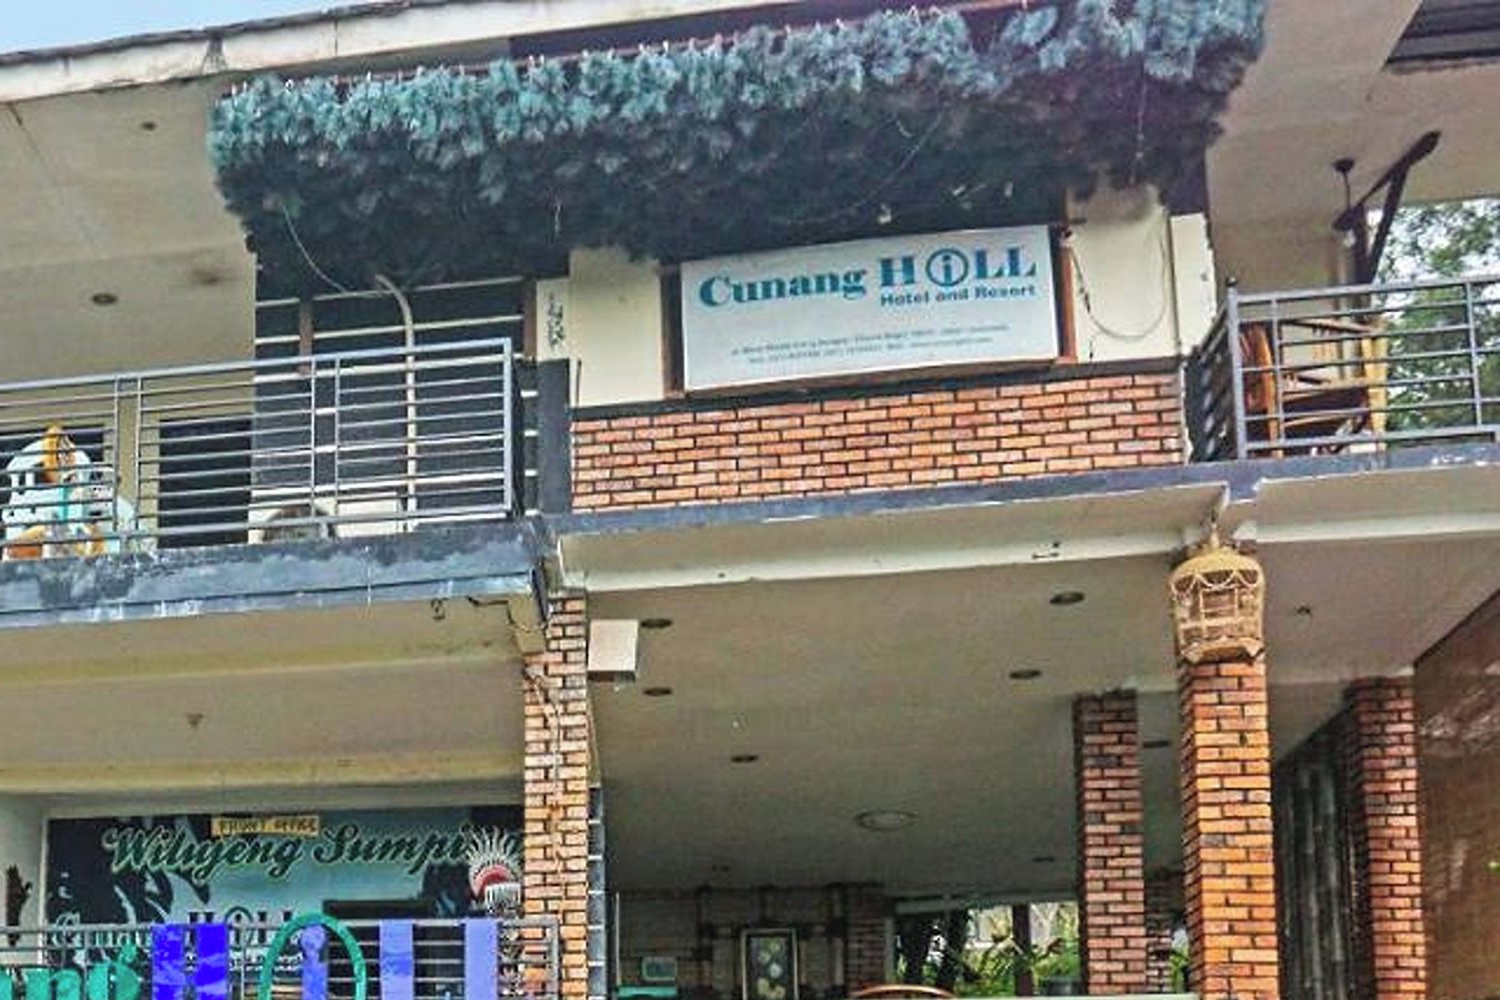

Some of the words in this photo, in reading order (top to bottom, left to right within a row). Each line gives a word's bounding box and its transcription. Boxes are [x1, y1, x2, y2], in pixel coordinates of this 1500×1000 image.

[699, 268, 867, 307] Cunang
[880, 290, 930, 306] Hotel
[935, 287, 969, 302] and
[974, 284, 1035, 299] Resort
